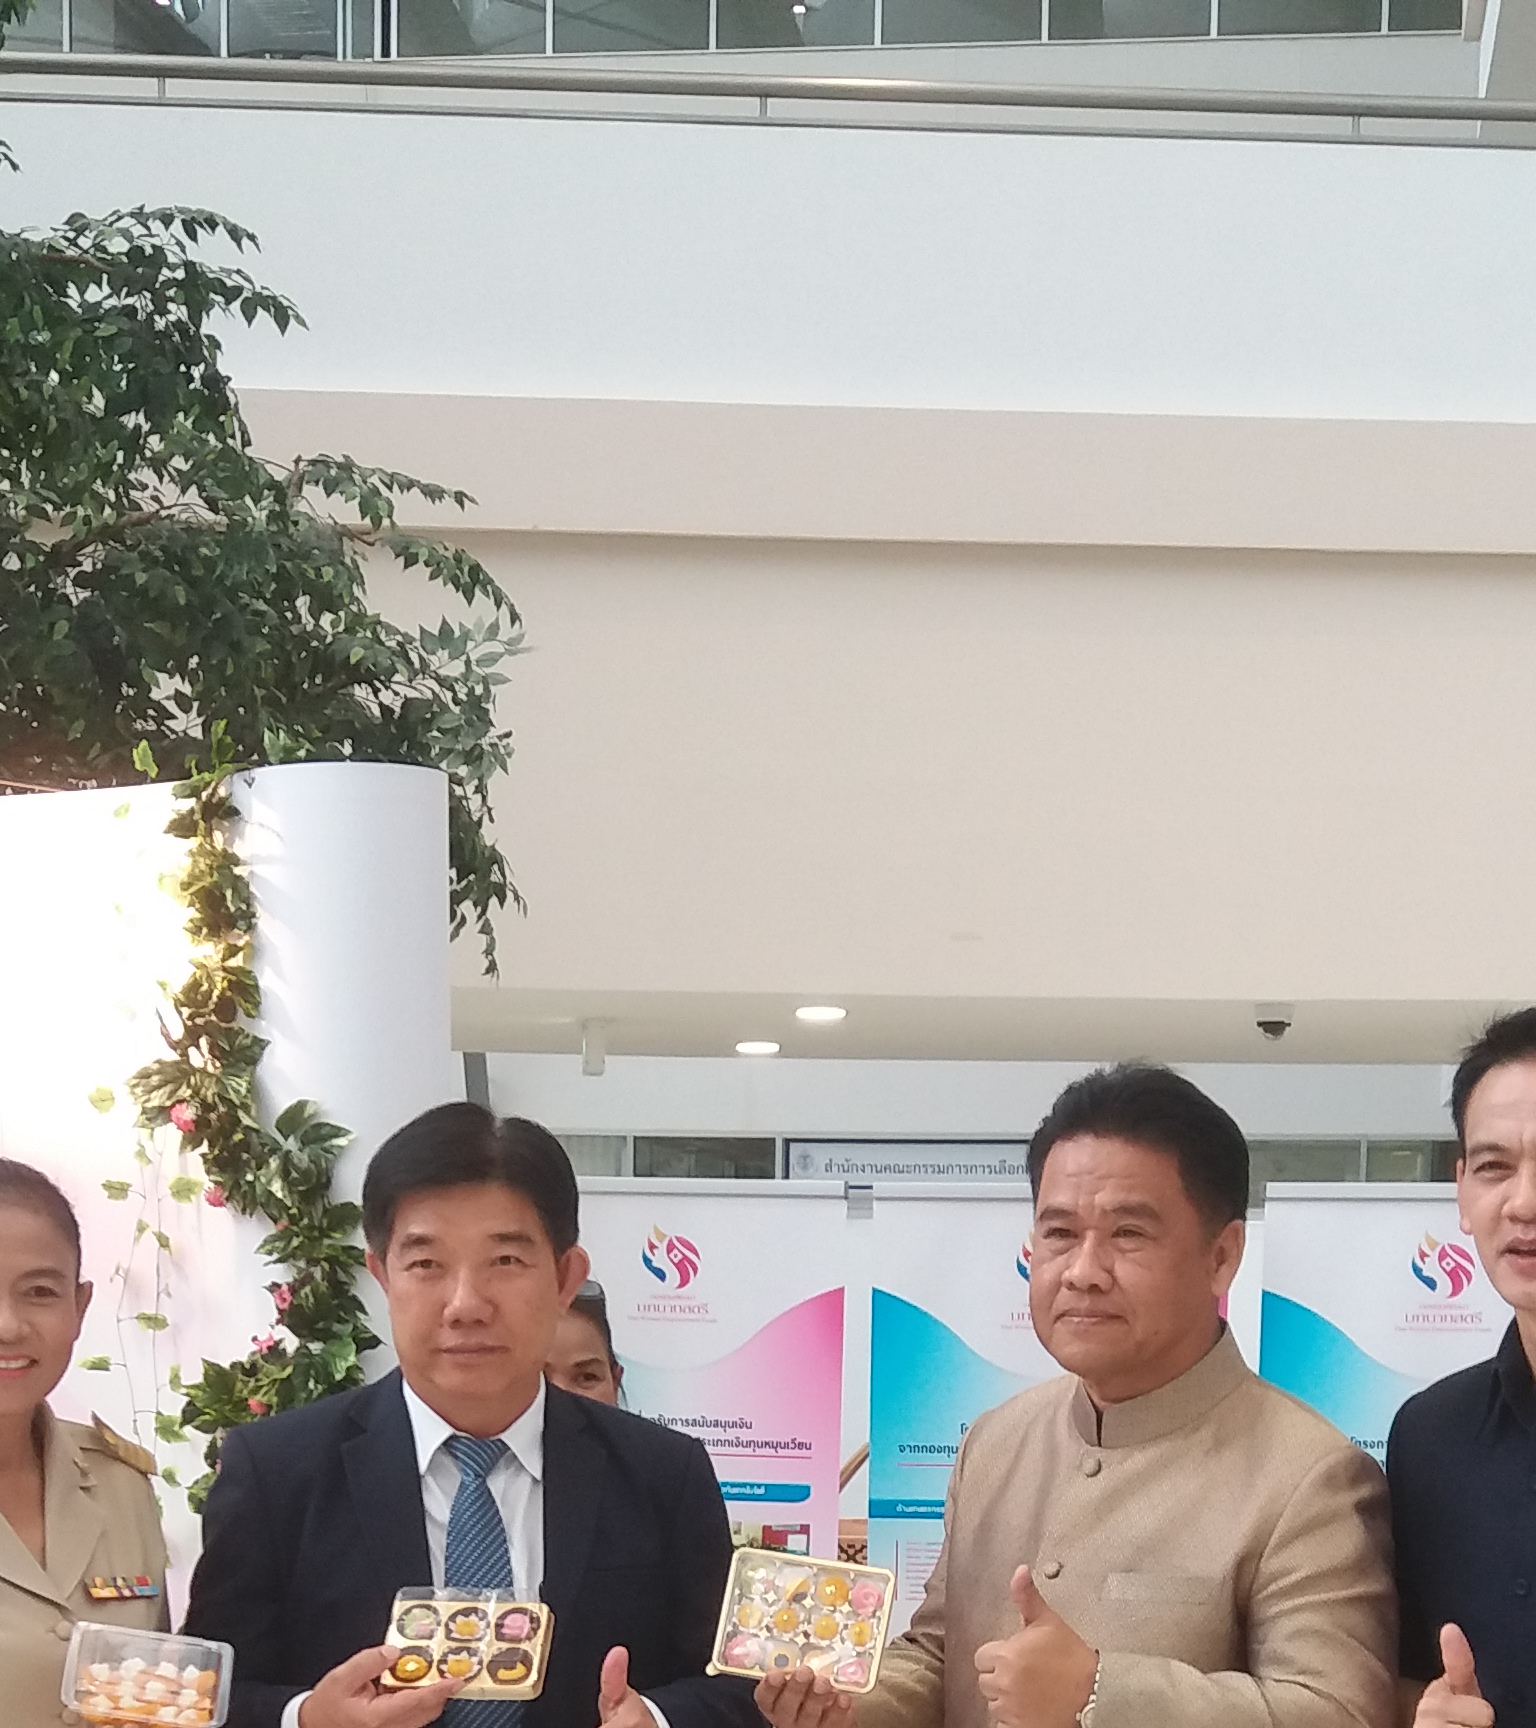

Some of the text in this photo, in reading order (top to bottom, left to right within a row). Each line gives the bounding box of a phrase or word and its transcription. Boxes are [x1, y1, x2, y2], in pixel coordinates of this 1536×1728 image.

[824, 1157, 1029, 1176] สำนักงานคณะกรรมการการเลือก
